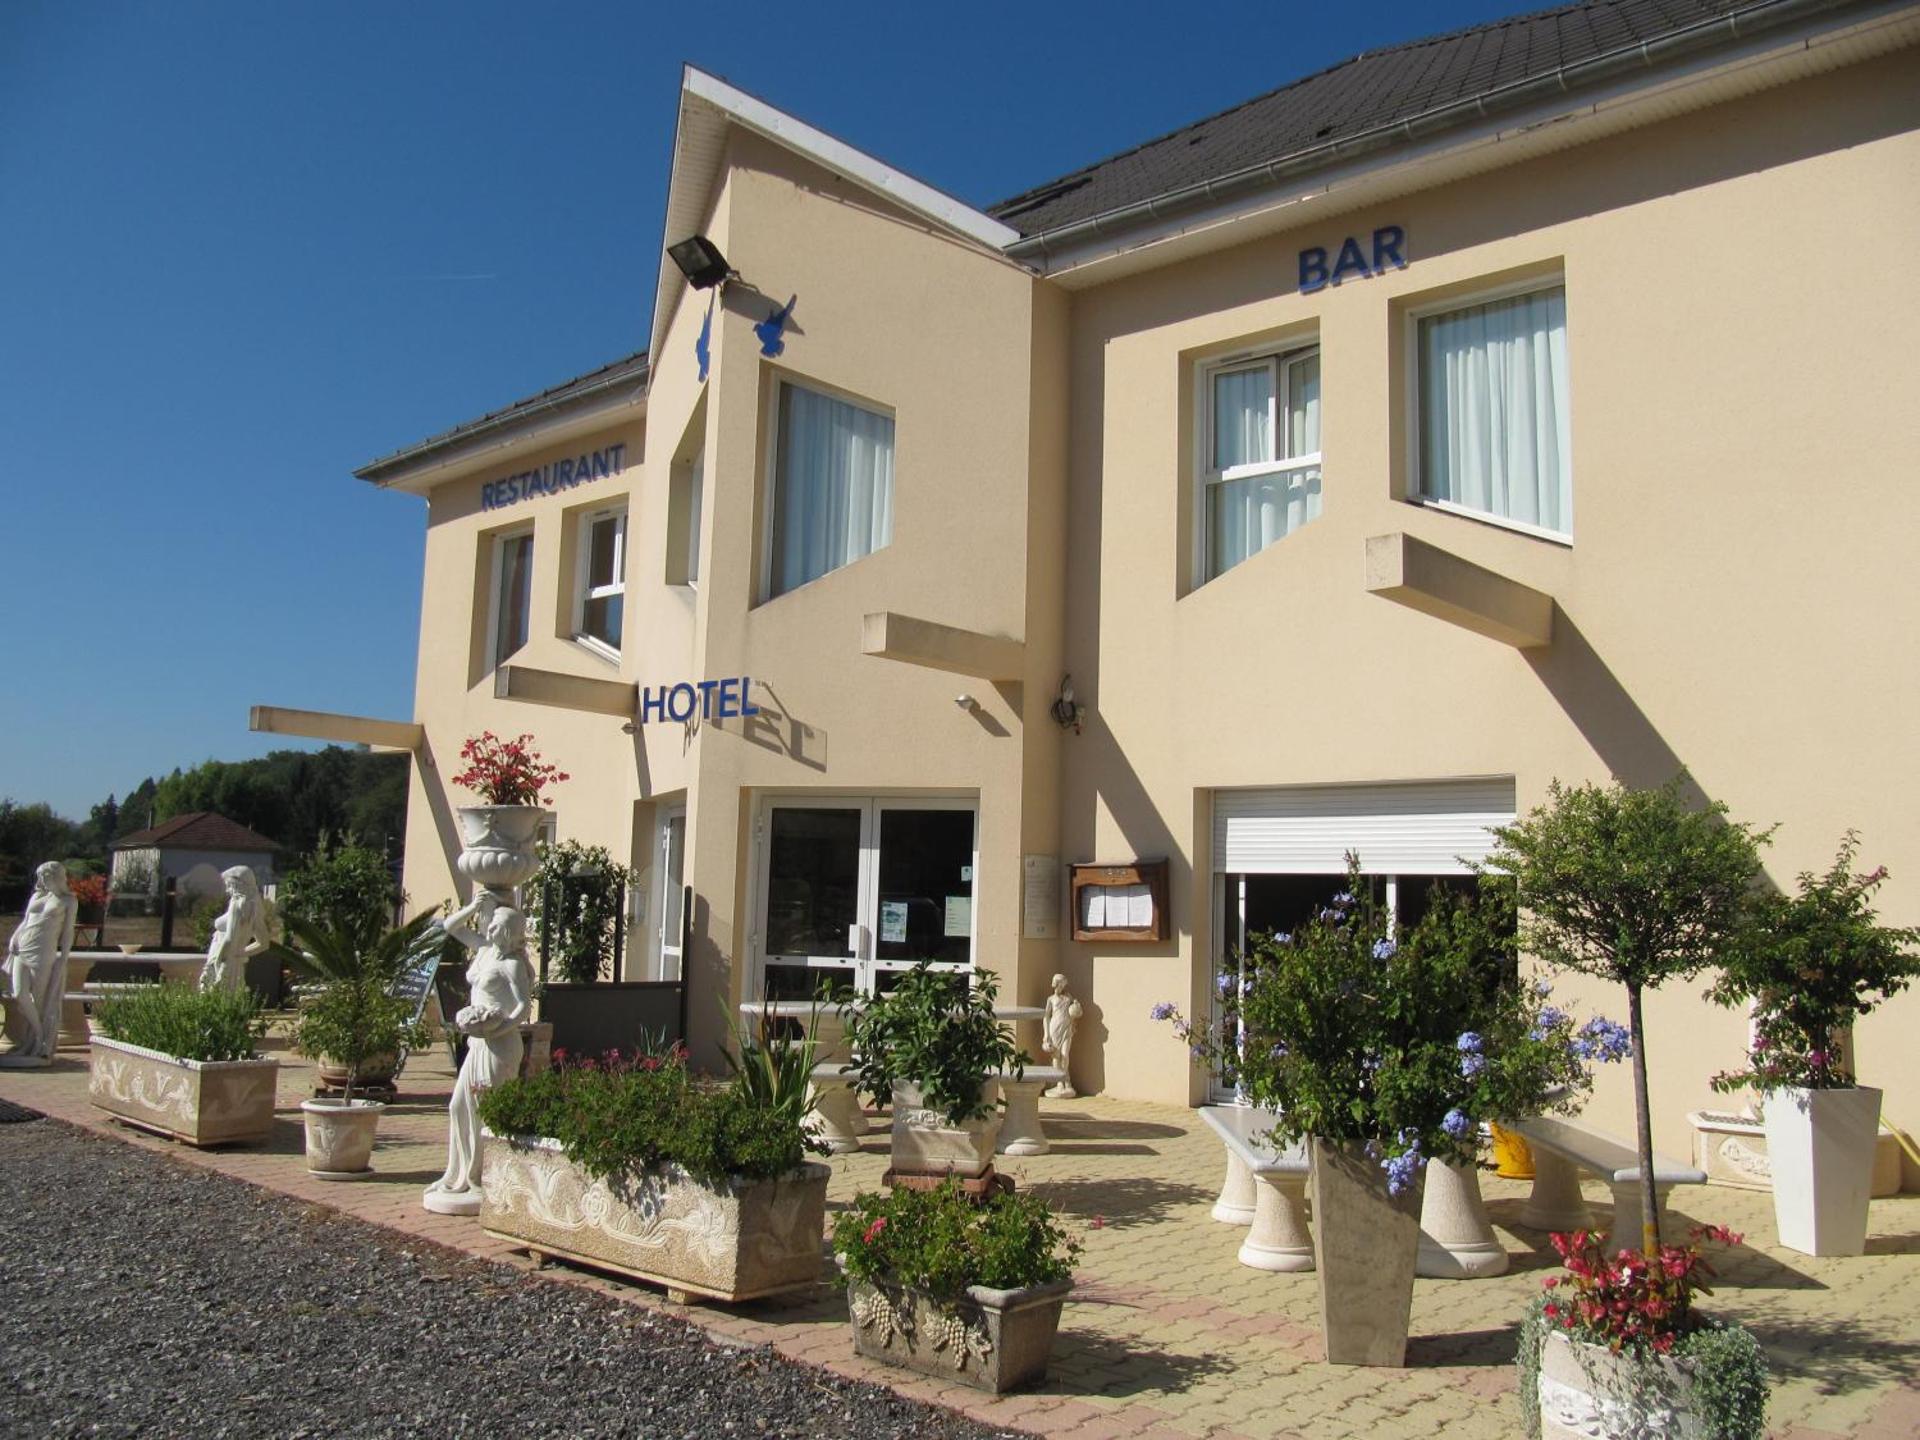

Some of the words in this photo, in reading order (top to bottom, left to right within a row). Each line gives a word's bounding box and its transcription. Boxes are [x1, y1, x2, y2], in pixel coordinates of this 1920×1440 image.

[1299, 225, 1407, 294] BAR
[482, 444, 624, 511] RESTAURANT
[642, 676, 759, 723] HOTEL
